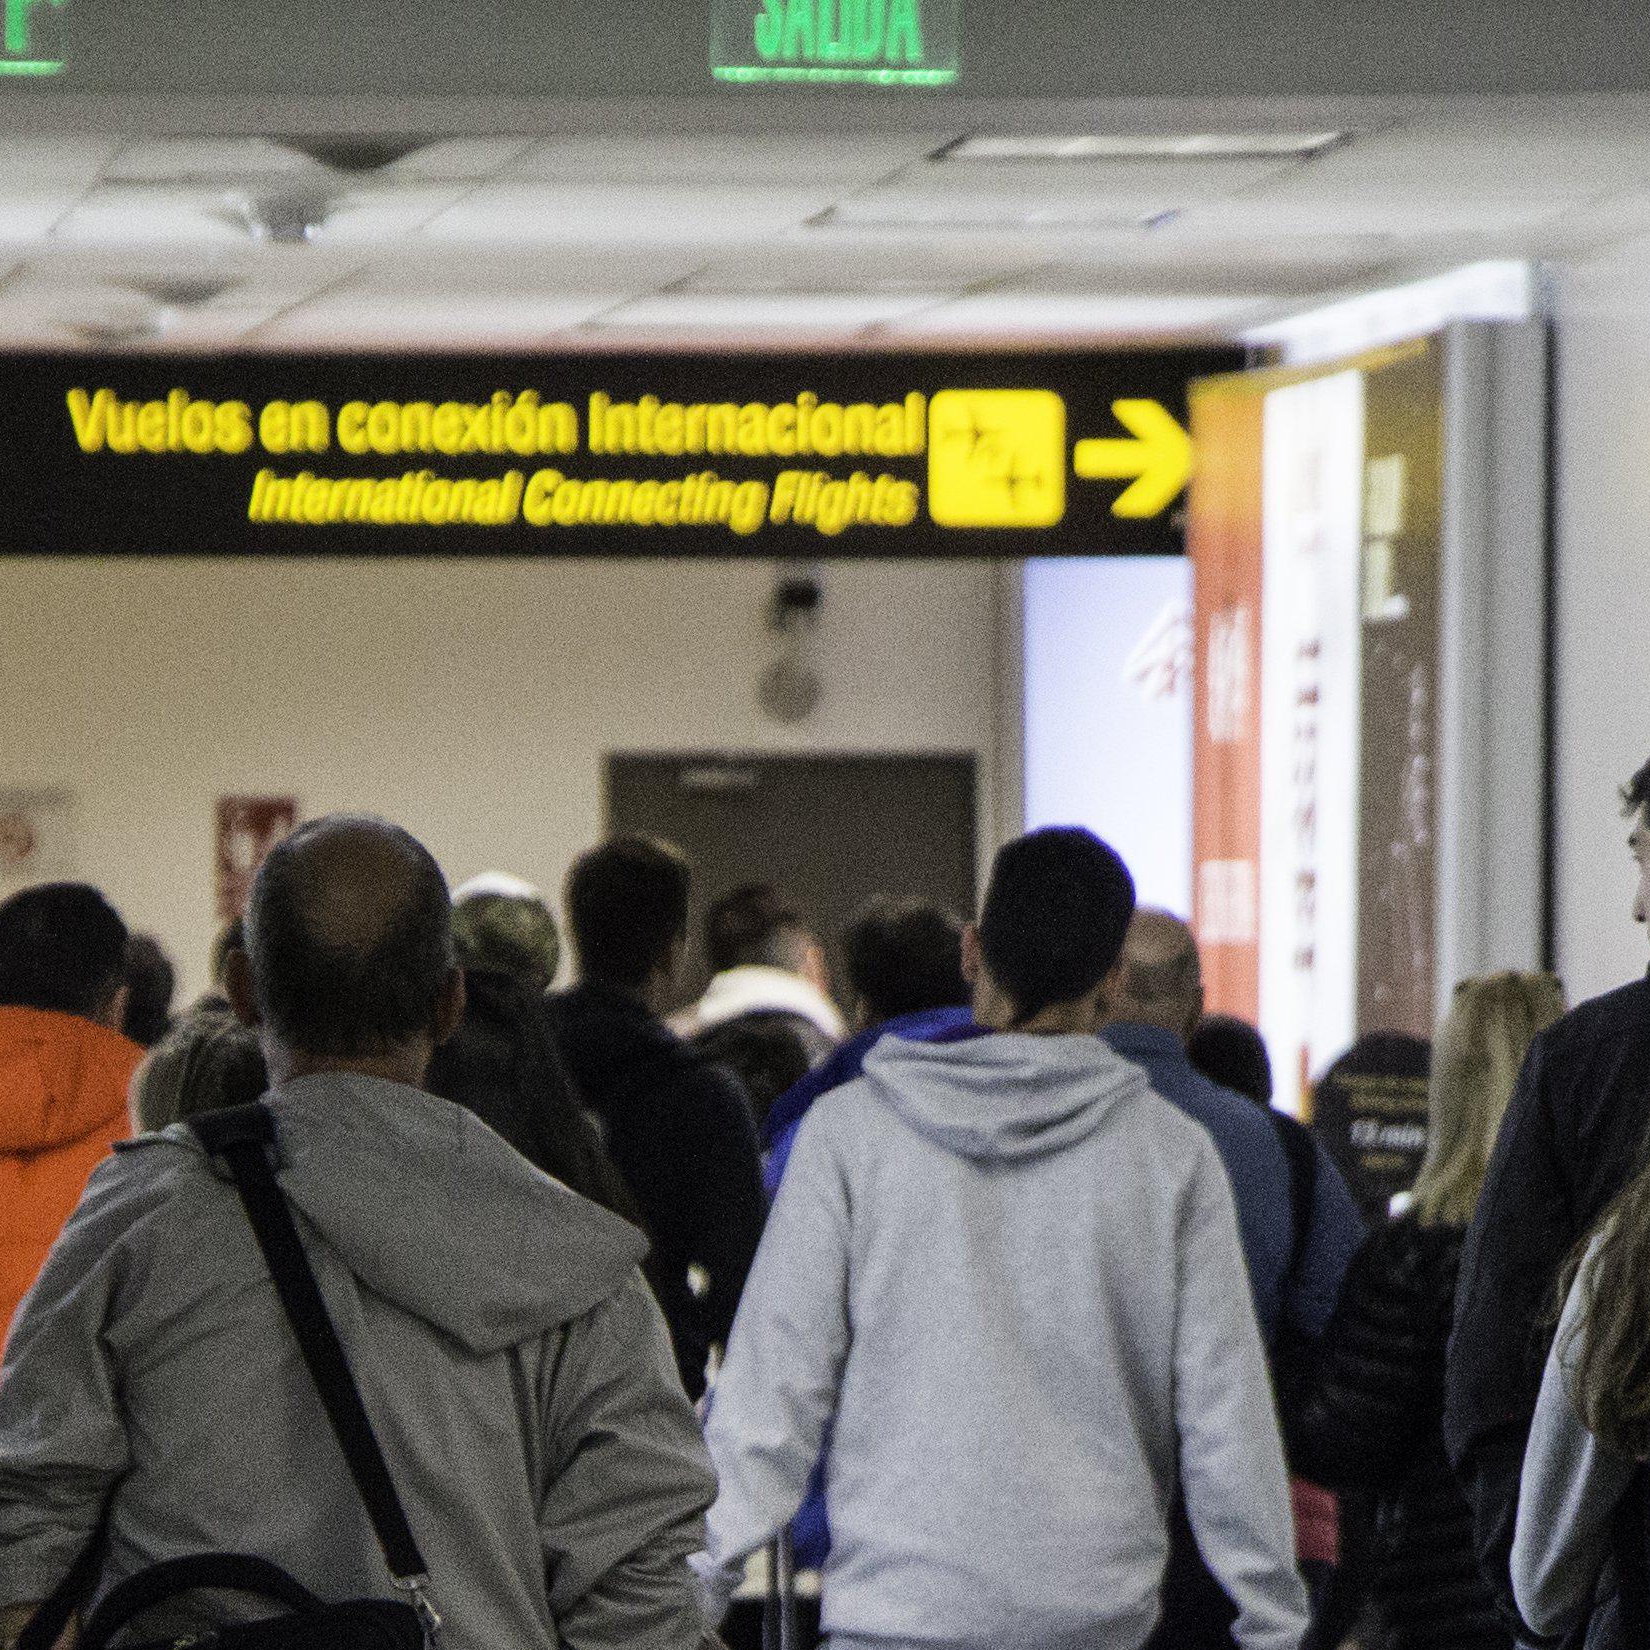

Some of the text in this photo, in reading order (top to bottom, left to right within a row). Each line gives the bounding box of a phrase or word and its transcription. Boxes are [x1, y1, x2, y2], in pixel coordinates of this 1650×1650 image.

[66, 387, 926, 457] Vuelos en conexión Internacional
[248, 467, 919, 536] International Connecting Flights
